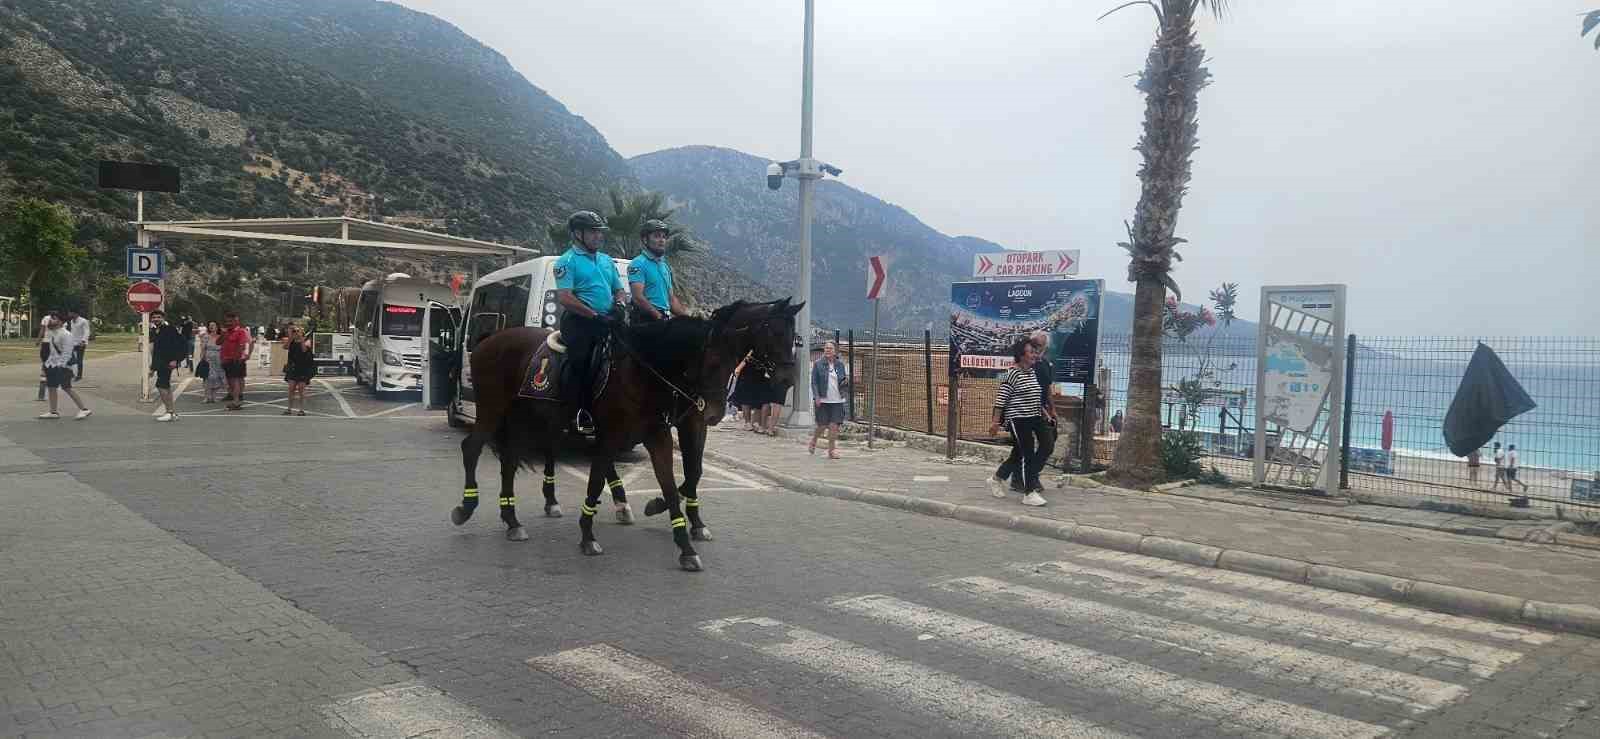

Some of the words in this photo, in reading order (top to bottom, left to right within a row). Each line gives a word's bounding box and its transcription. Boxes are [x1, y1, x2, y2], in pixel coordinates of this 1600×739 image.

[138, 255, 151, 271] D
[1007, 252, 1044, 263] OTOPARK
[996, 264, 1013, 274] CAR
[1016, 263, 1053, 274] PARKING
[1007, 289, 1032, 297] LAGOON
